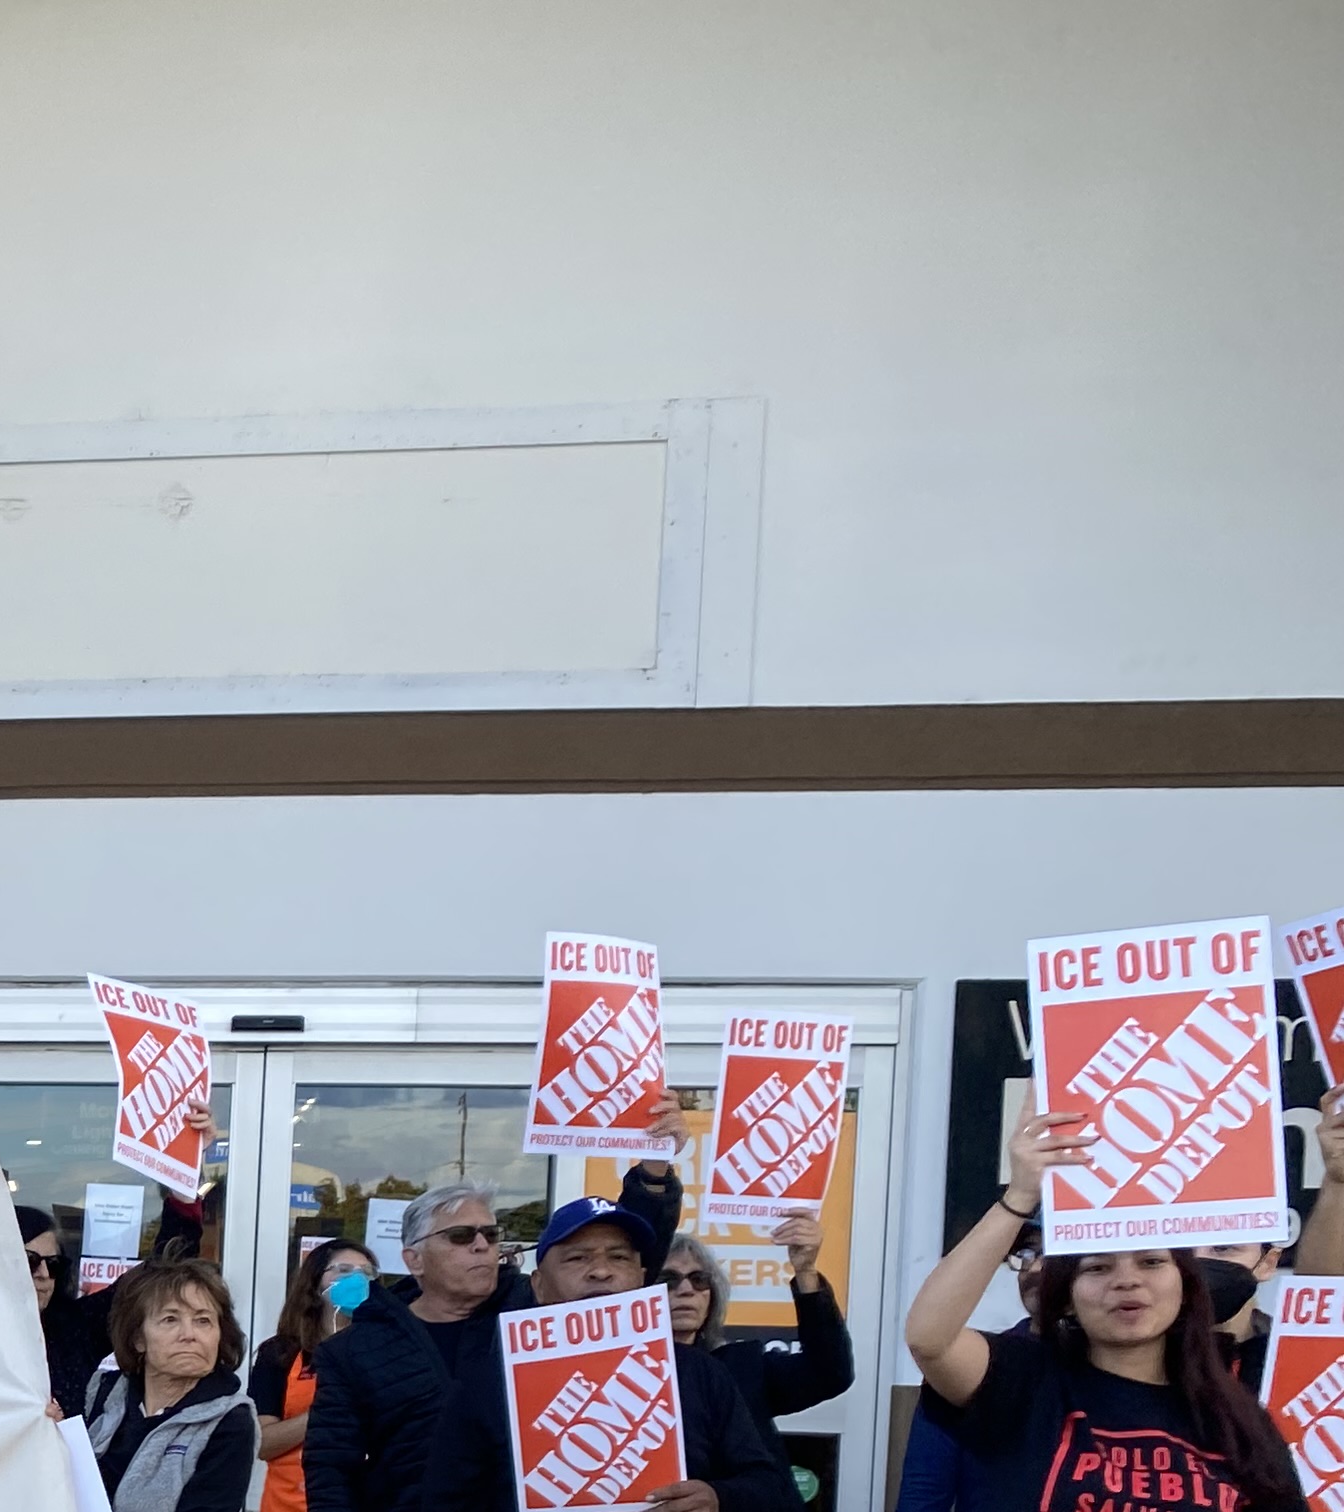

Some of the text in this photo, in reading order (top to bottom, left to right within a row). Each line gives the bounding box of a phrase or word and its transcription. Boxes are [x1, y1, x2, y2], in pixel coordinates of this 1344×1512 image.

[551, 941, 655, 980] ICE OUT OF
[1038, 929, 1261, 992] ICE OUT OF
[1285, 923, 1336, 966] ICE
[94, 981, 197, 1028] ICE OUT OF
[557, 996, 615, 1056] THE
[127, 1030, 165, 1074] THE
[537, 988, 660, 1126] HOME
[728, 1017, 849, 1053] ICE OUT OF
[1066, 1016, 1160, 1104] THE
[122, 1032, 208, 1142] HOME
[732, 1071, 790, 1128] THE
[1049, 988, 1270, 1209] HOME
[530, 1133, 573, 1146] PROTECT
[575, 1136, 596, 1147] OUR
[712, 1060, 843, 1196] HOME
[761, 1112, 837, 1198] DEPOT
[1137, 1063, 1272, 1204] DEPOT
[708, 1202, 748, 1216] PROTECT
[750, 1204, 768, 1217] OUR
[1054, 1221, 1121, 1241] PROTECT
[1126, 1217, 1158, 1237] OUR
[82, 1262, 103, 1278] ICE
[508, 1296, 663, 1354] ICE OUT OF
[1281, 1287, 1335, 1325] ICE
[523, 1343, 672, 1507] HOME
[532, 1370, 599, 1437] THE
[587, 1399, 677, 1504] DEPOT
